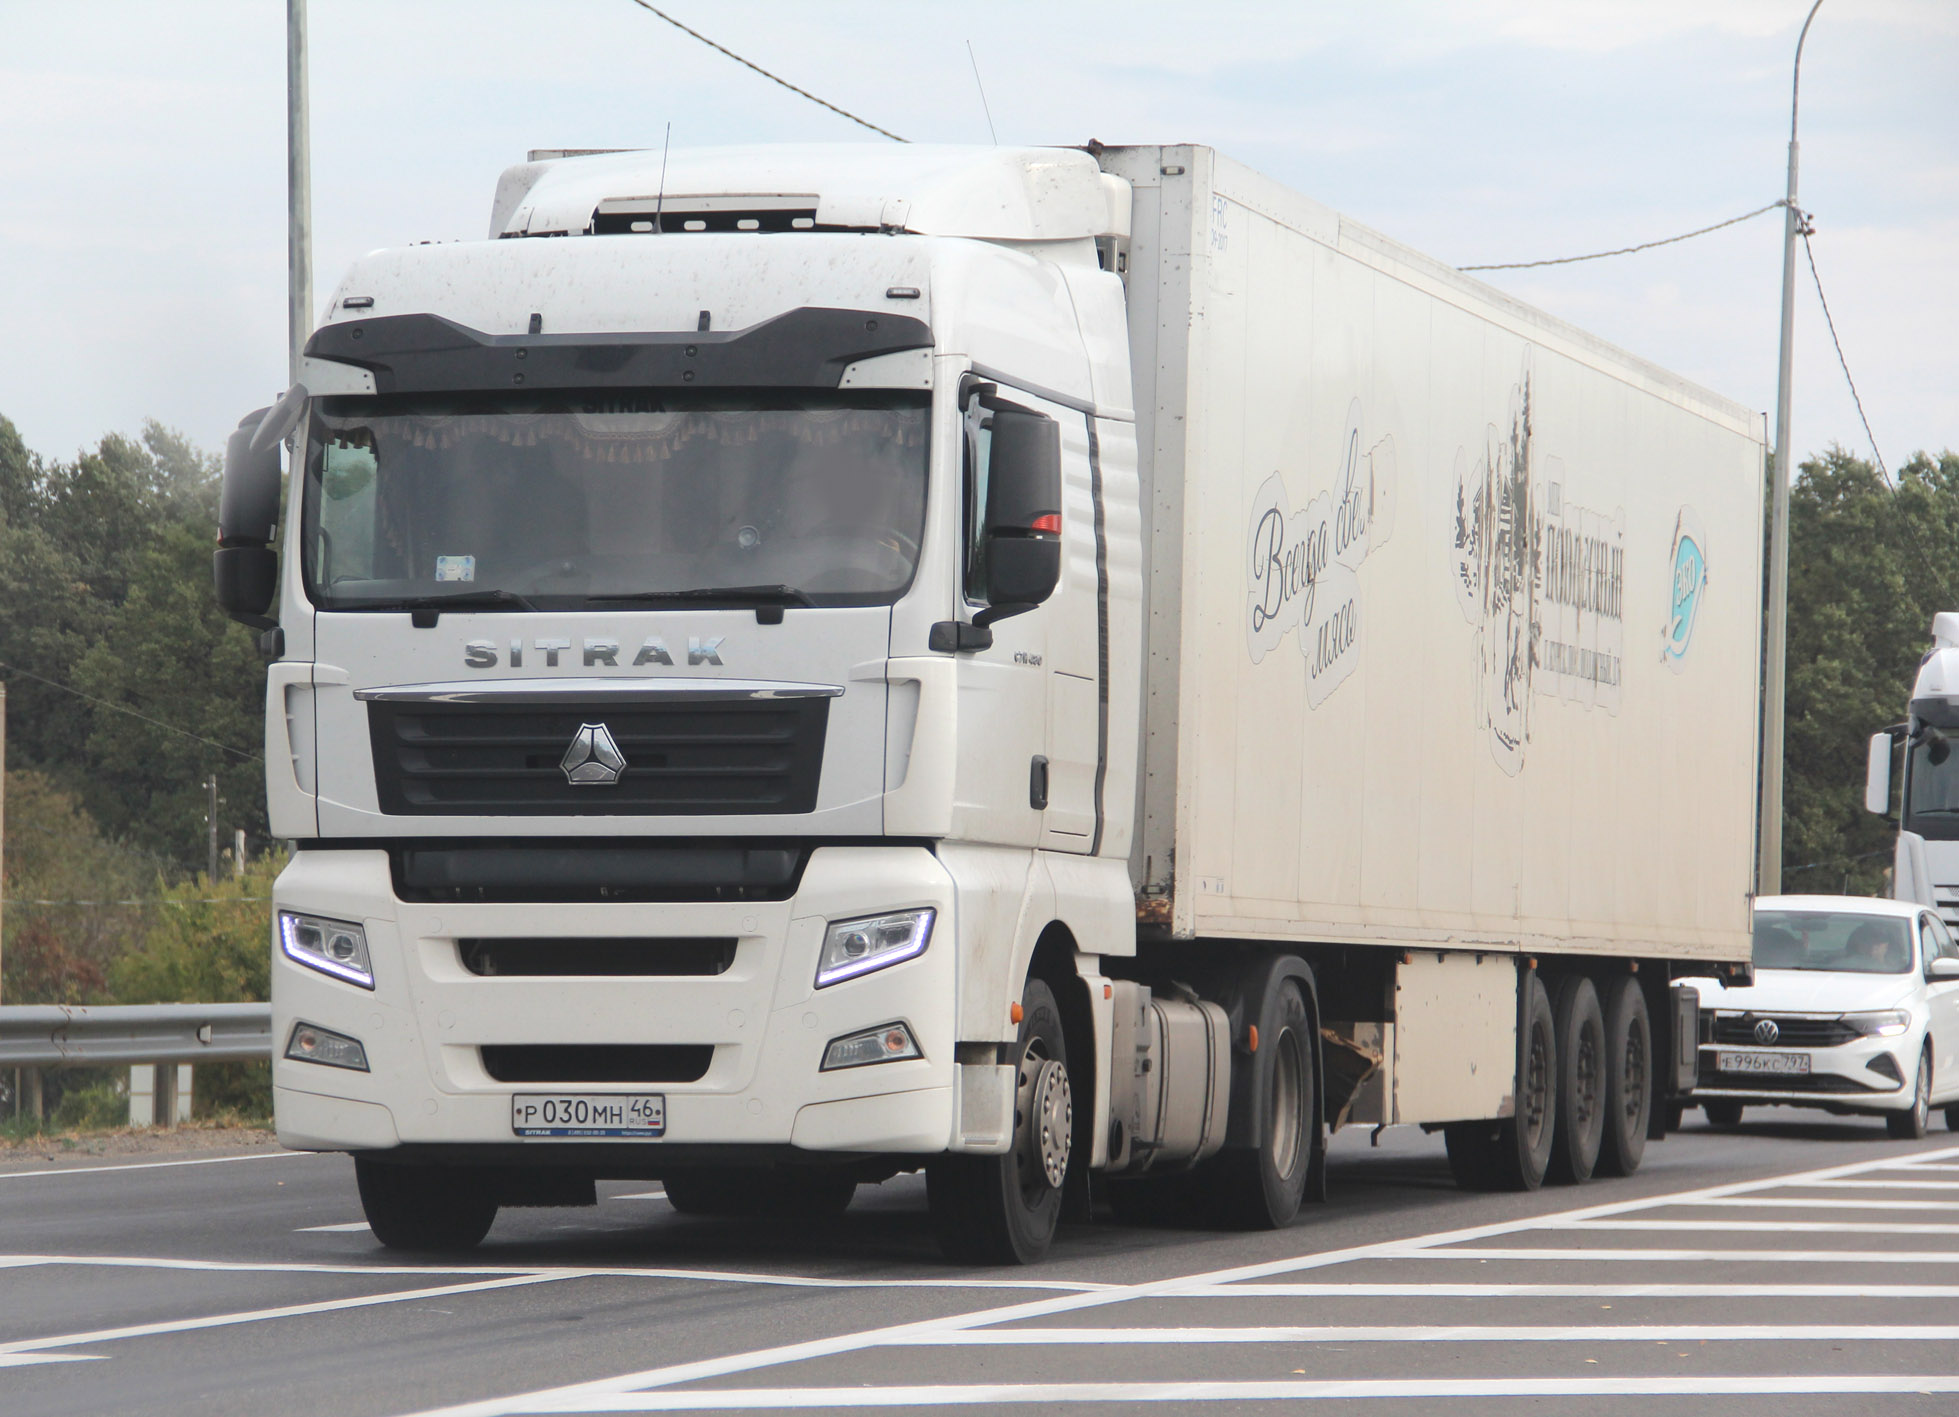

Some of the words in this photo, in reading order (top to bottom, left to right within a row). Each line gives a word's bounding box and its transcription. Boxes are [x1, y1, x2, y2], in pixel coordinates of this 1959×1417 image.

[464, 636, 726, 668] SITRAK
[630, 1099, 654, 1117] 46
[629, 1117, 647, 1125] RUS
